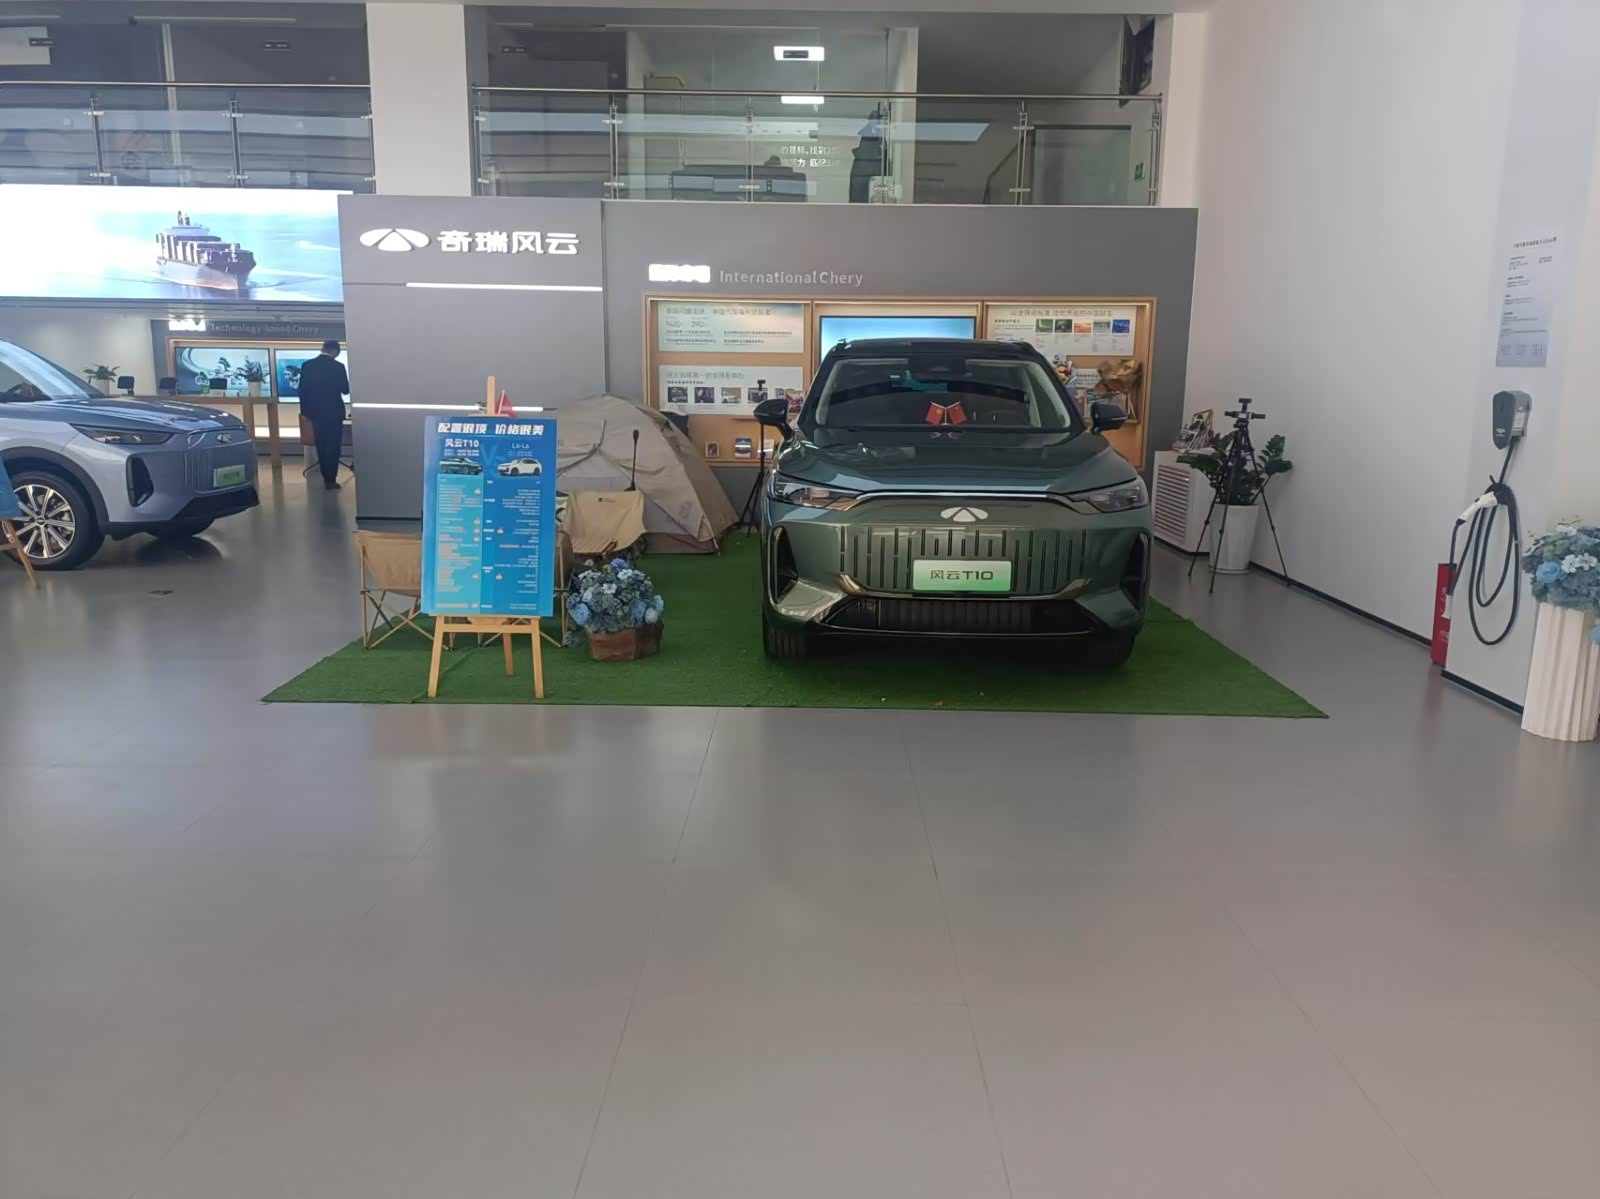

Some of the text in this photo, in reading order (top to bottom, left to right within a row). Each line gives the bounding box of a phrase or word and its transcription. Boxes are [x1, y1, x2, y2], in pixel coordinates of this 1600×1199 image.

[437, 230, 580, 254] 奇瑞风云
[720, 270, 817, 284] International
[819, 271, 863, 287] Chery
[444, 438, 480, 448] 风云T10
[930, 569, 994, 581] 风云T10
